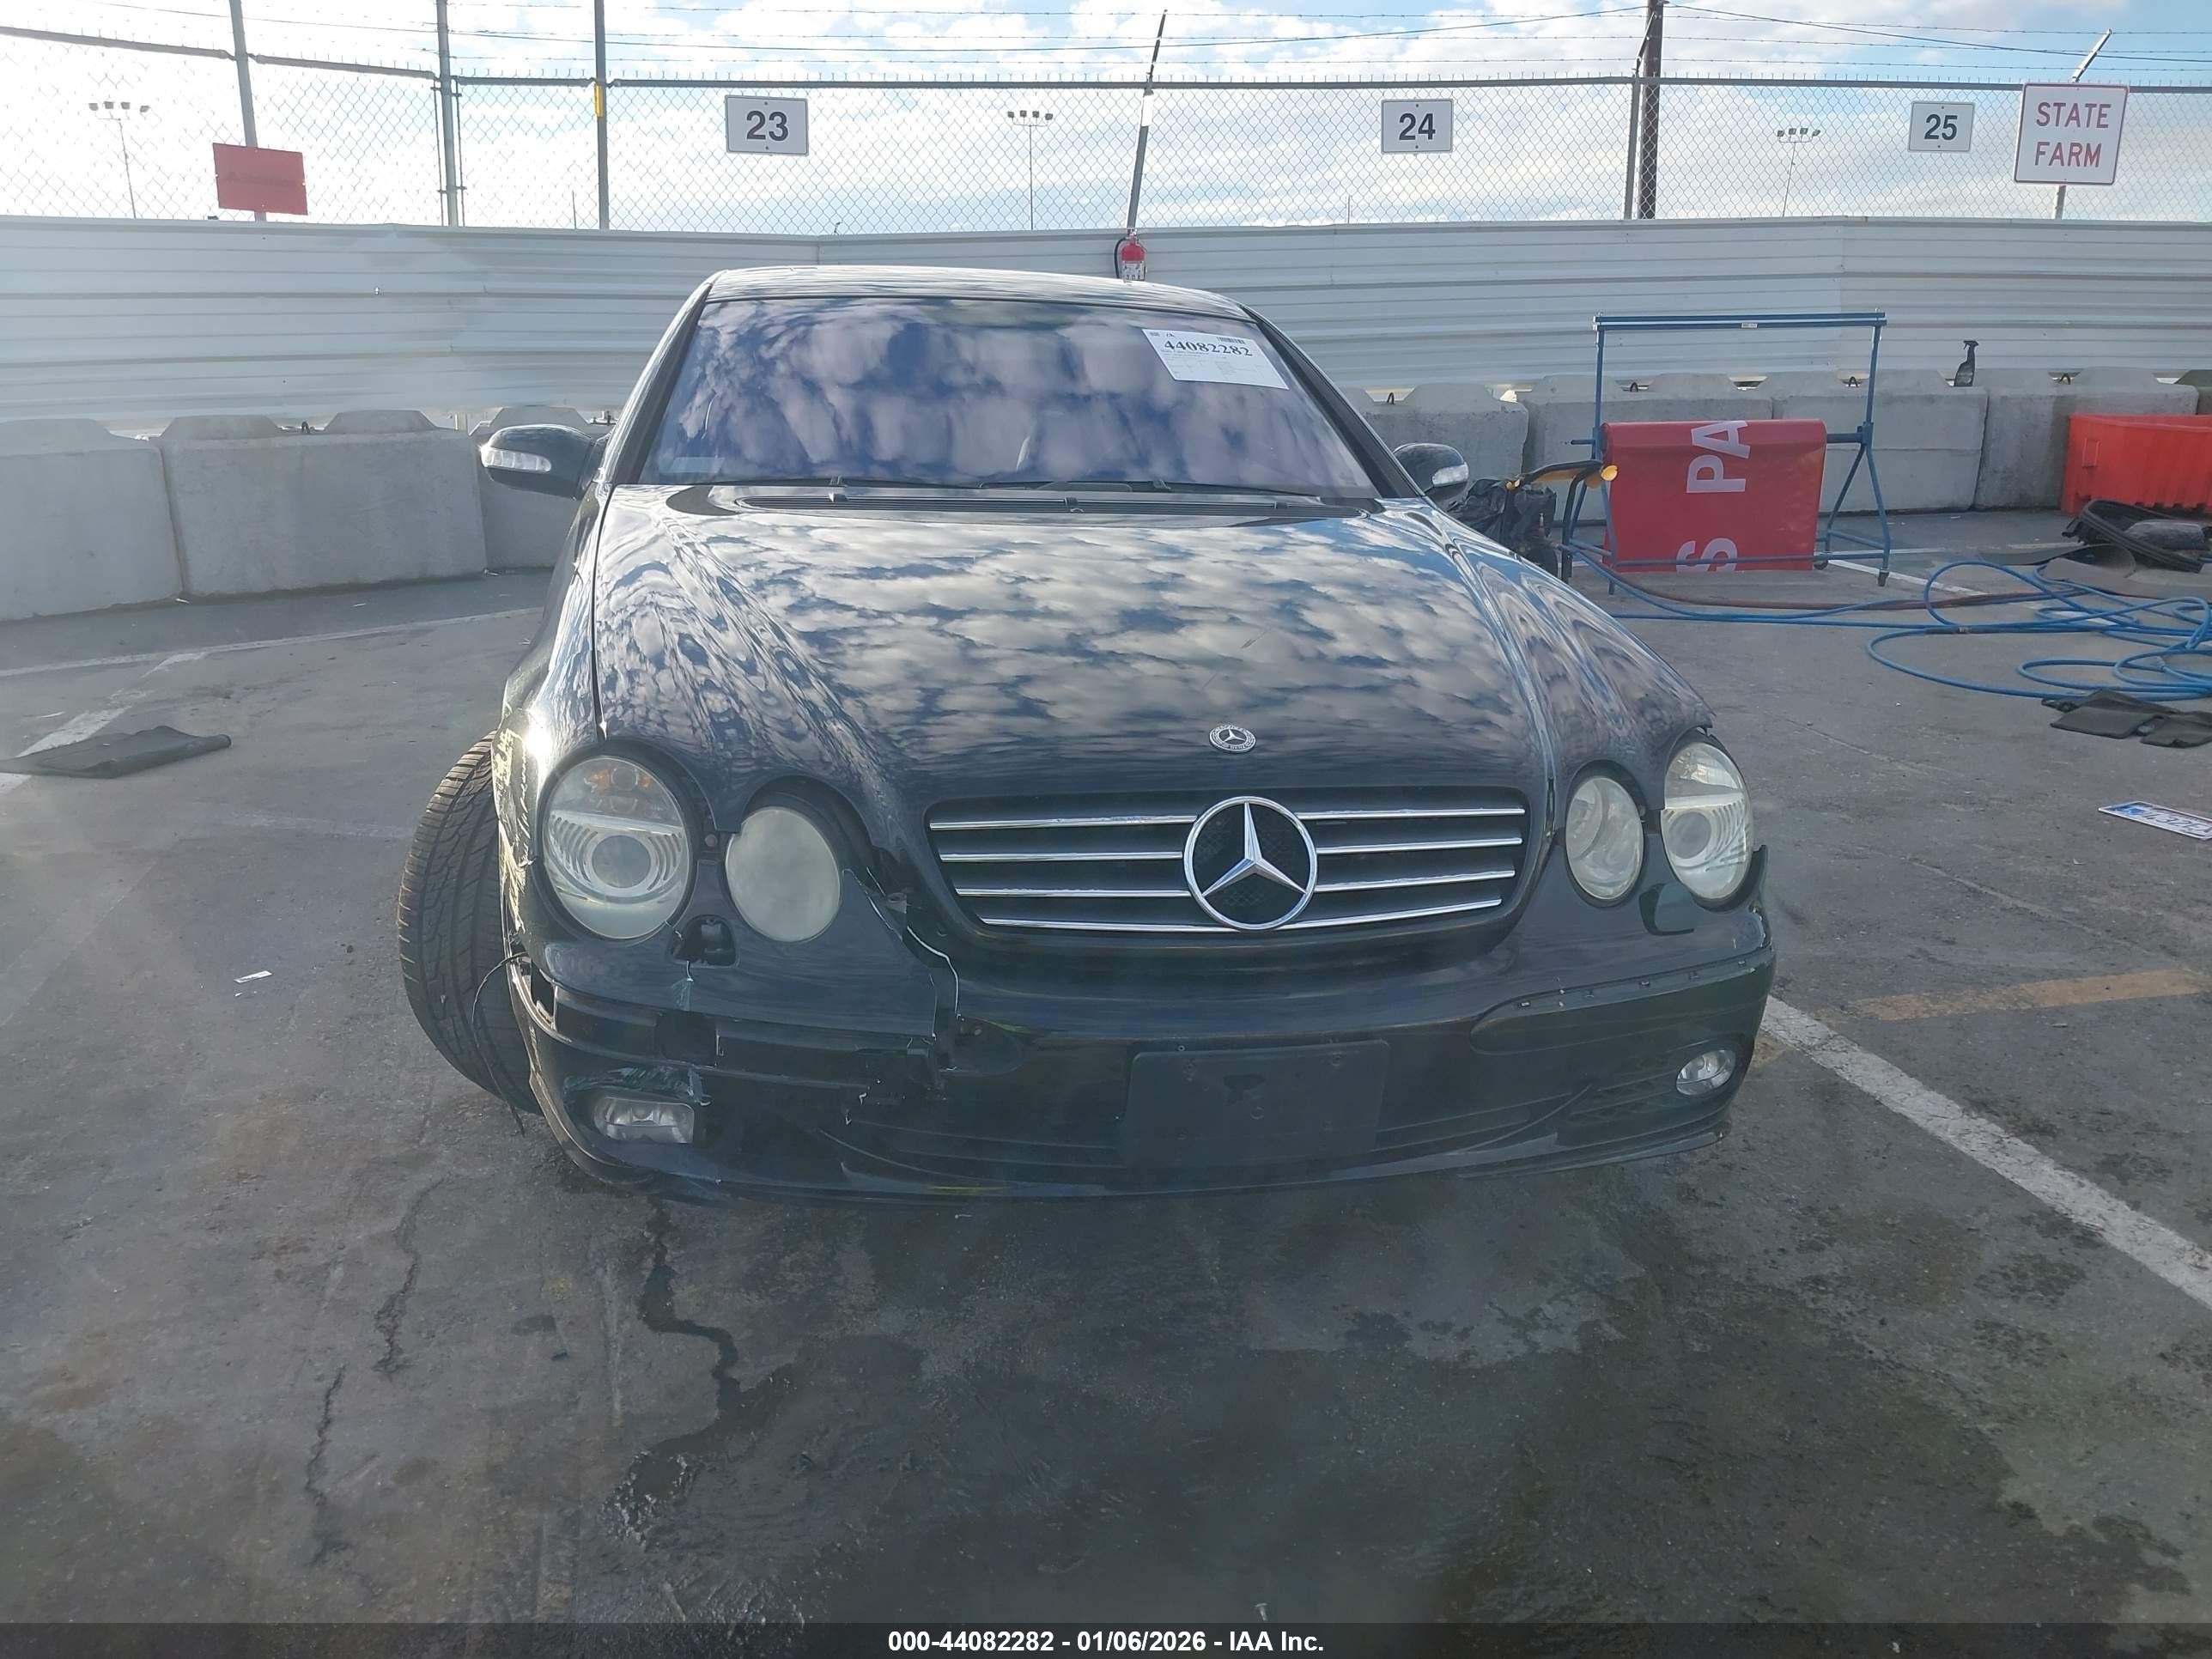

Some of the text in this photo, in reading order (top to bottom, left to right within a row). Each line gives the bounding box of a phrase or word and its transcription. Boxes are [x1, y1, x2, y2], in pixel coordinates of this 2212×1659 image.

[746, 110, 788, 142] 23
[1399, 112, 1436, 140] 24
[1923, 114, 1958, 141] 25
[2036, 101, 2112, 129] STATE
[2034, 141, 2101, 167] FARM
[1164, 340, 1252, 356] 44082282
